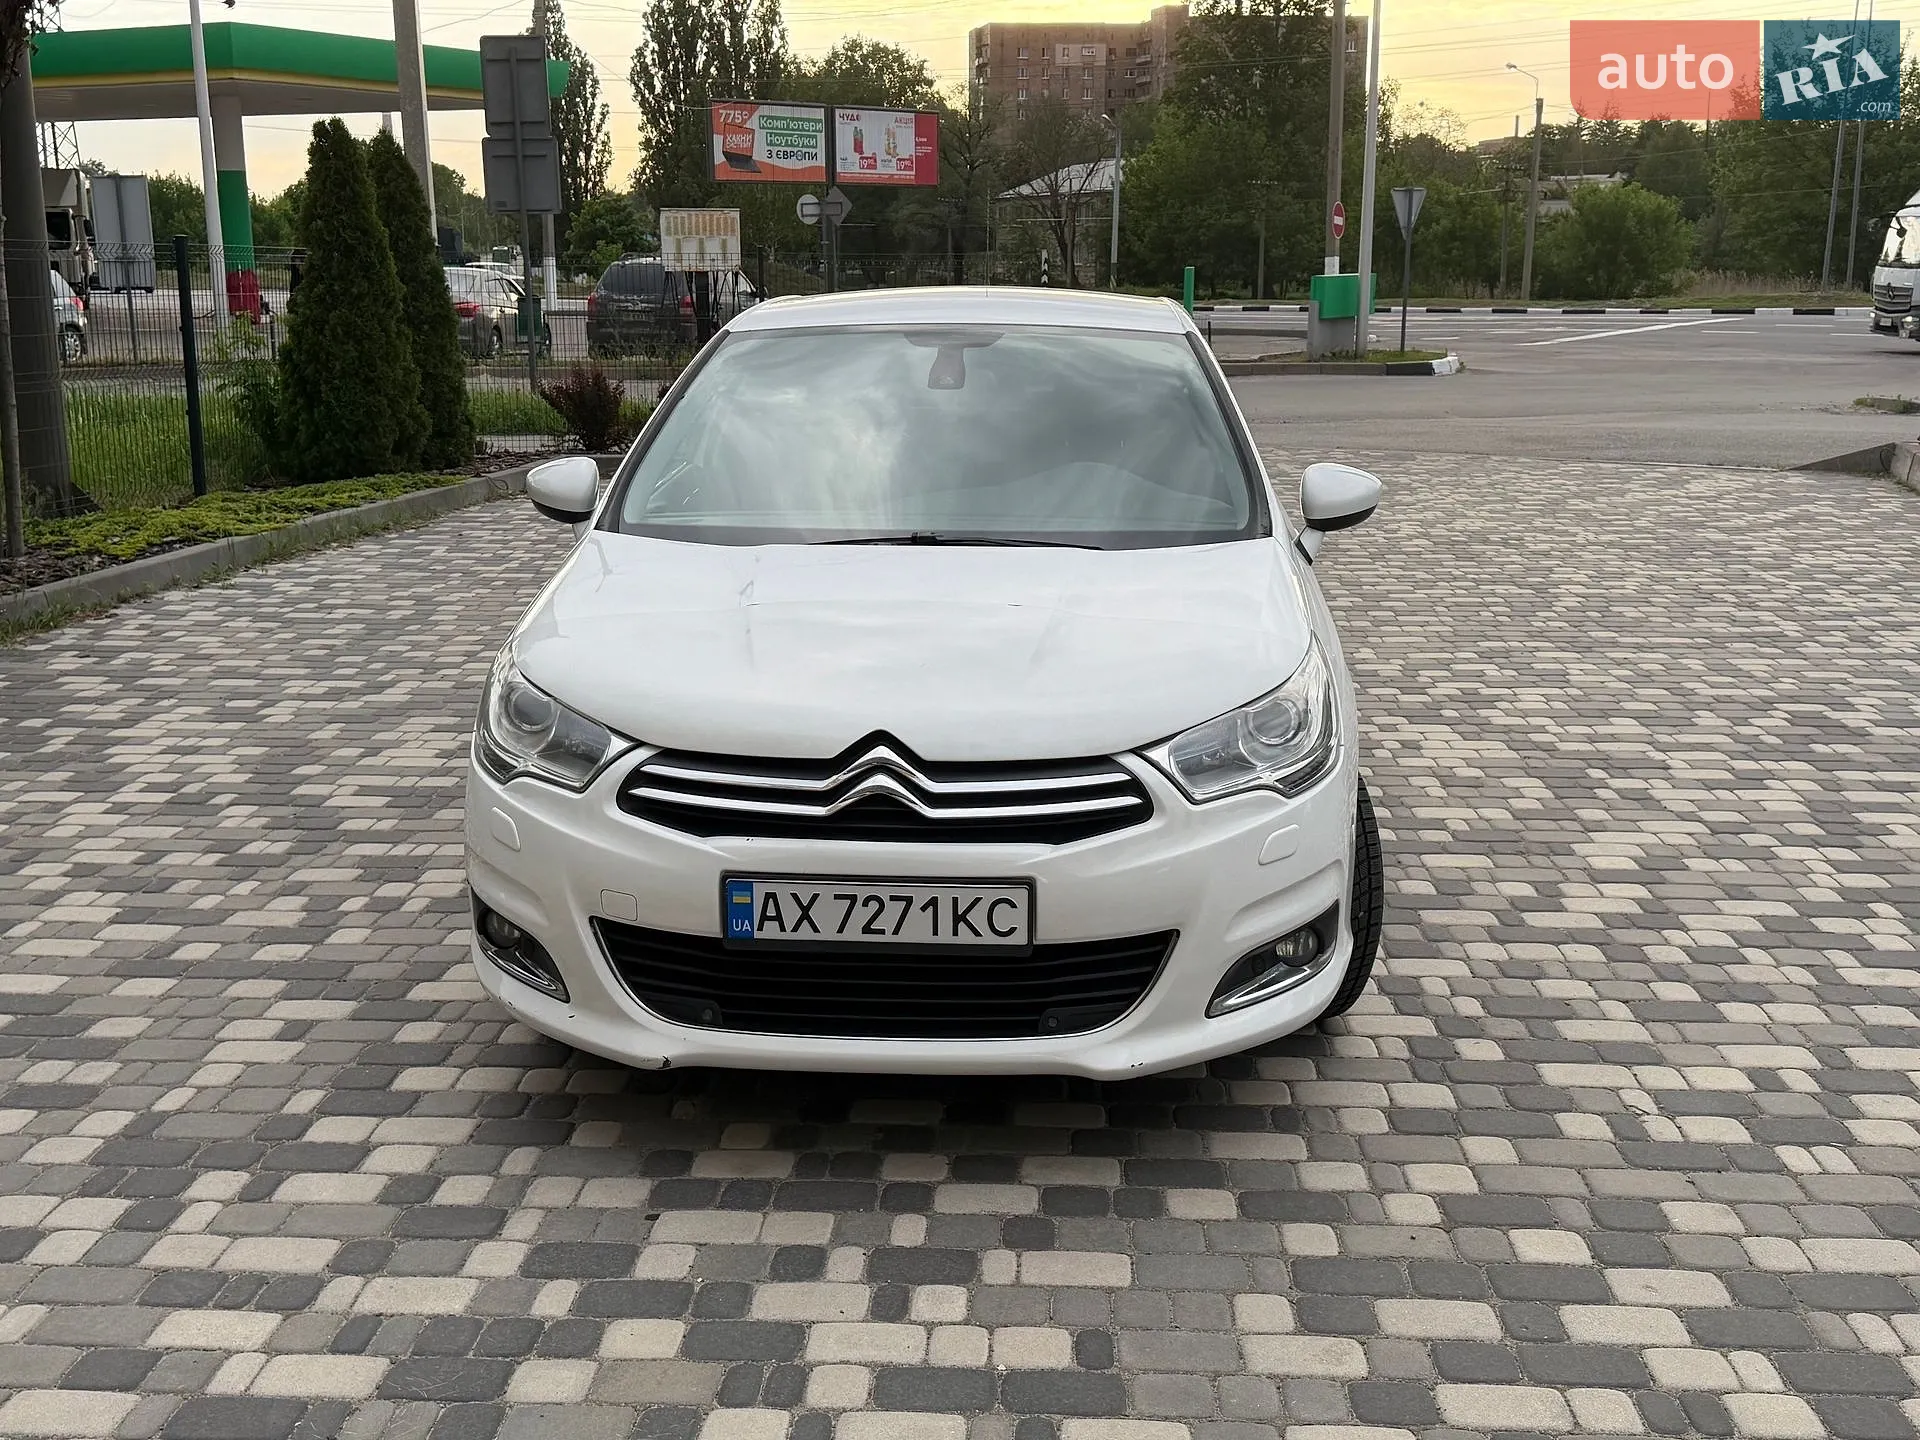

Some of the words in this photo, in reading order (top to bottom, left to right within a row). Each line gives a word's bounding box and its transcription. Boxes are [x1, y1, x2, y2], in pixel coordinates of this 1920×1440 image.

[760, 116, 823, 131] Комп'ютери
[767, 133, 817, 147] Ноутбуки
[766, 149, 773, 160] З
[776, 149, 818, 161] ЄВРОПИ
[757, 891, 821, 934] AX
[833, 893, 939, 937] 7271
[952, 896, 1018, 938] KC
[733, 919, 751, 932] UA
